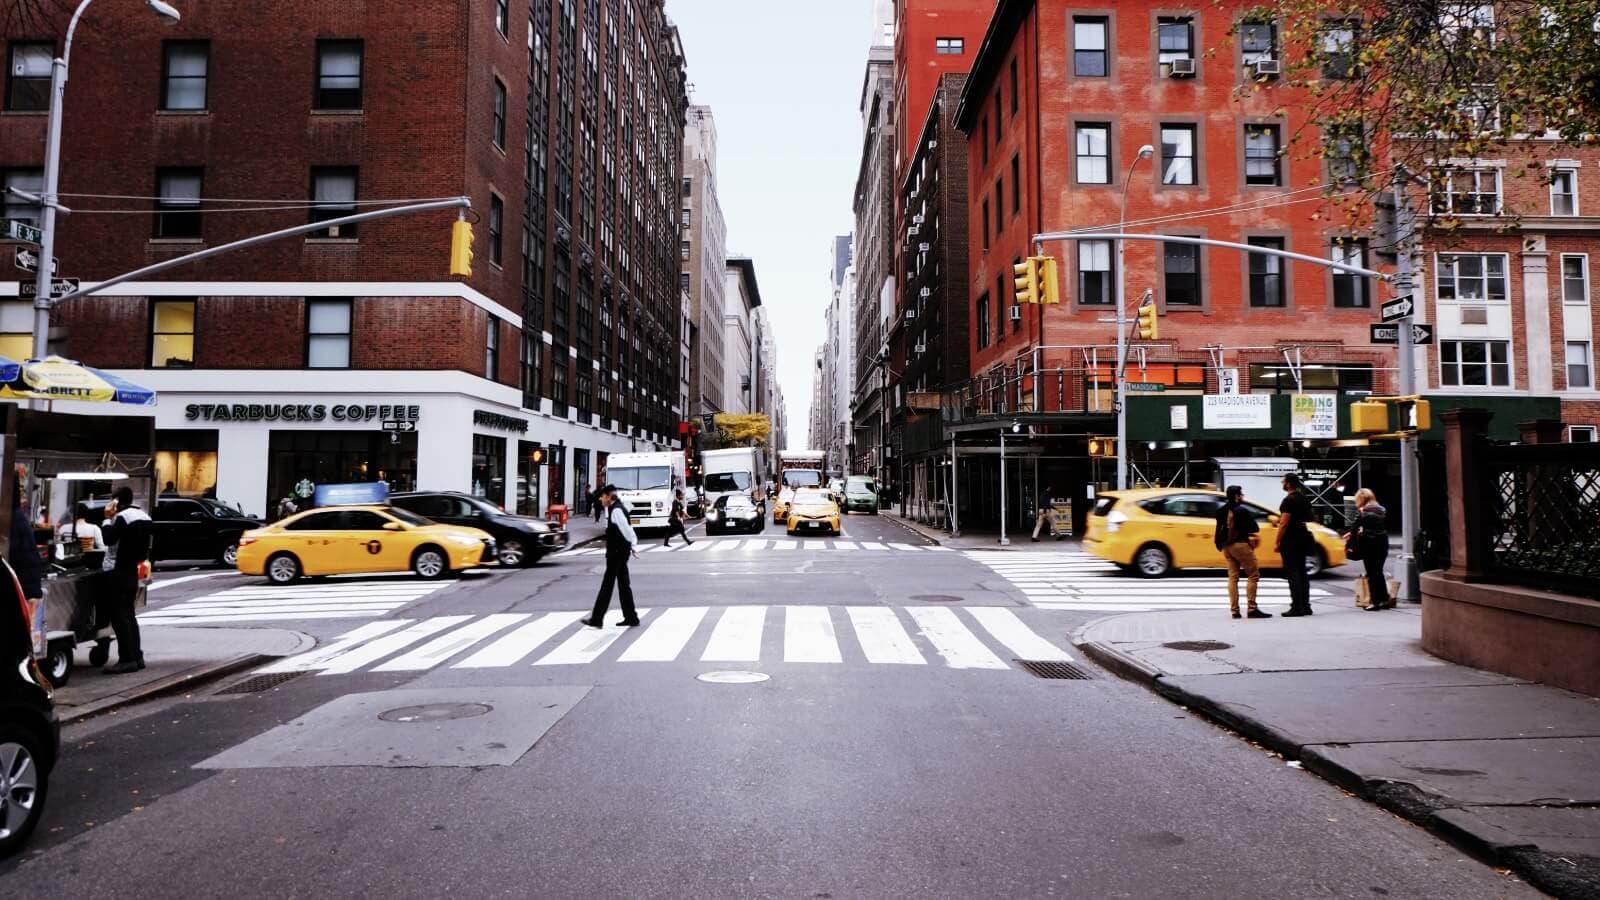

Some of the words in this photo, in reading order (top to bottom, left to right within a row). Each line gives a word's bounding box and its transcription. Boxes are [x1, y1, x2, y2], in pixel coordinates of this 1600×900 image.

[26, 228, 34, 240] 36
[1379, 330, 1398, 338] ONE
[1219, 396, 1244, 406] MADISON
[1245, 396, 1268, 406] AVENUE
[1295, 397, 1333, 408] SPRING
[185, 403, 326, 421] STARBUCKS
[331, 403, 420, 421] COFFEE
